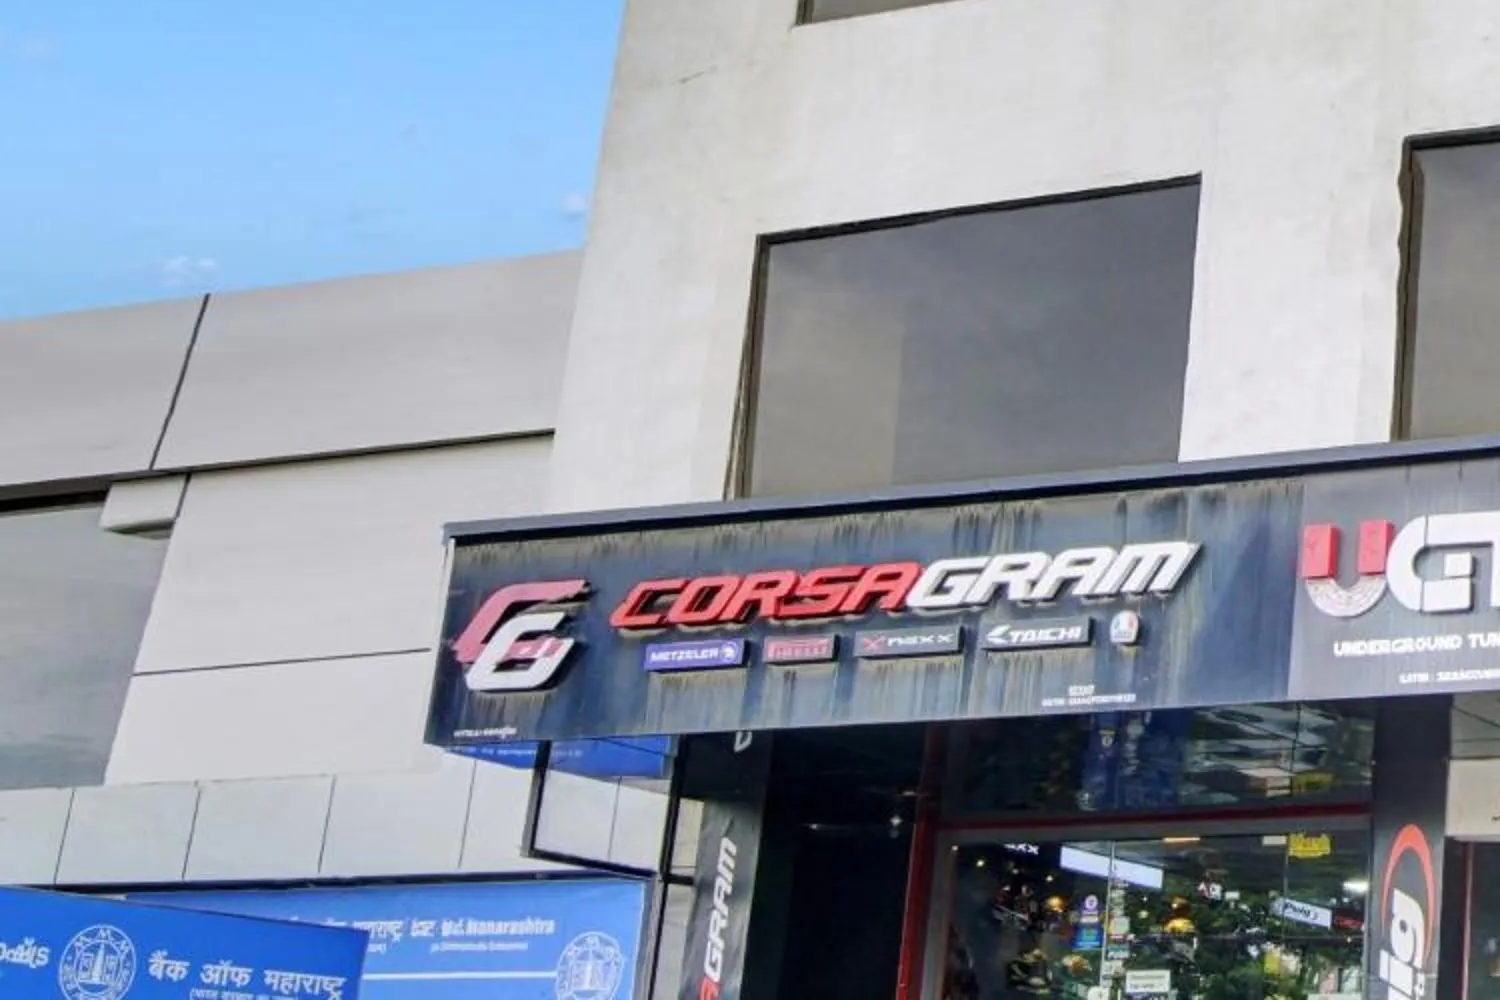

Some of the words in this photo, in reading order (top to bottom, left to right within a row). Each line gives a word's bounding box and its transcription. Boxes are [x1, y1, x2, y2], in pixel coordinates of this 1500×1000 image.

[610, 542, 1200, 628] CORSAGRAM
[1010, 626, 1083, 642] TAICHI
[1334, 634, 1462, 657] UNDERGROUND
[148, 950, 189, 982] बैंक
[200, 960, 252, 987] ऑफ
